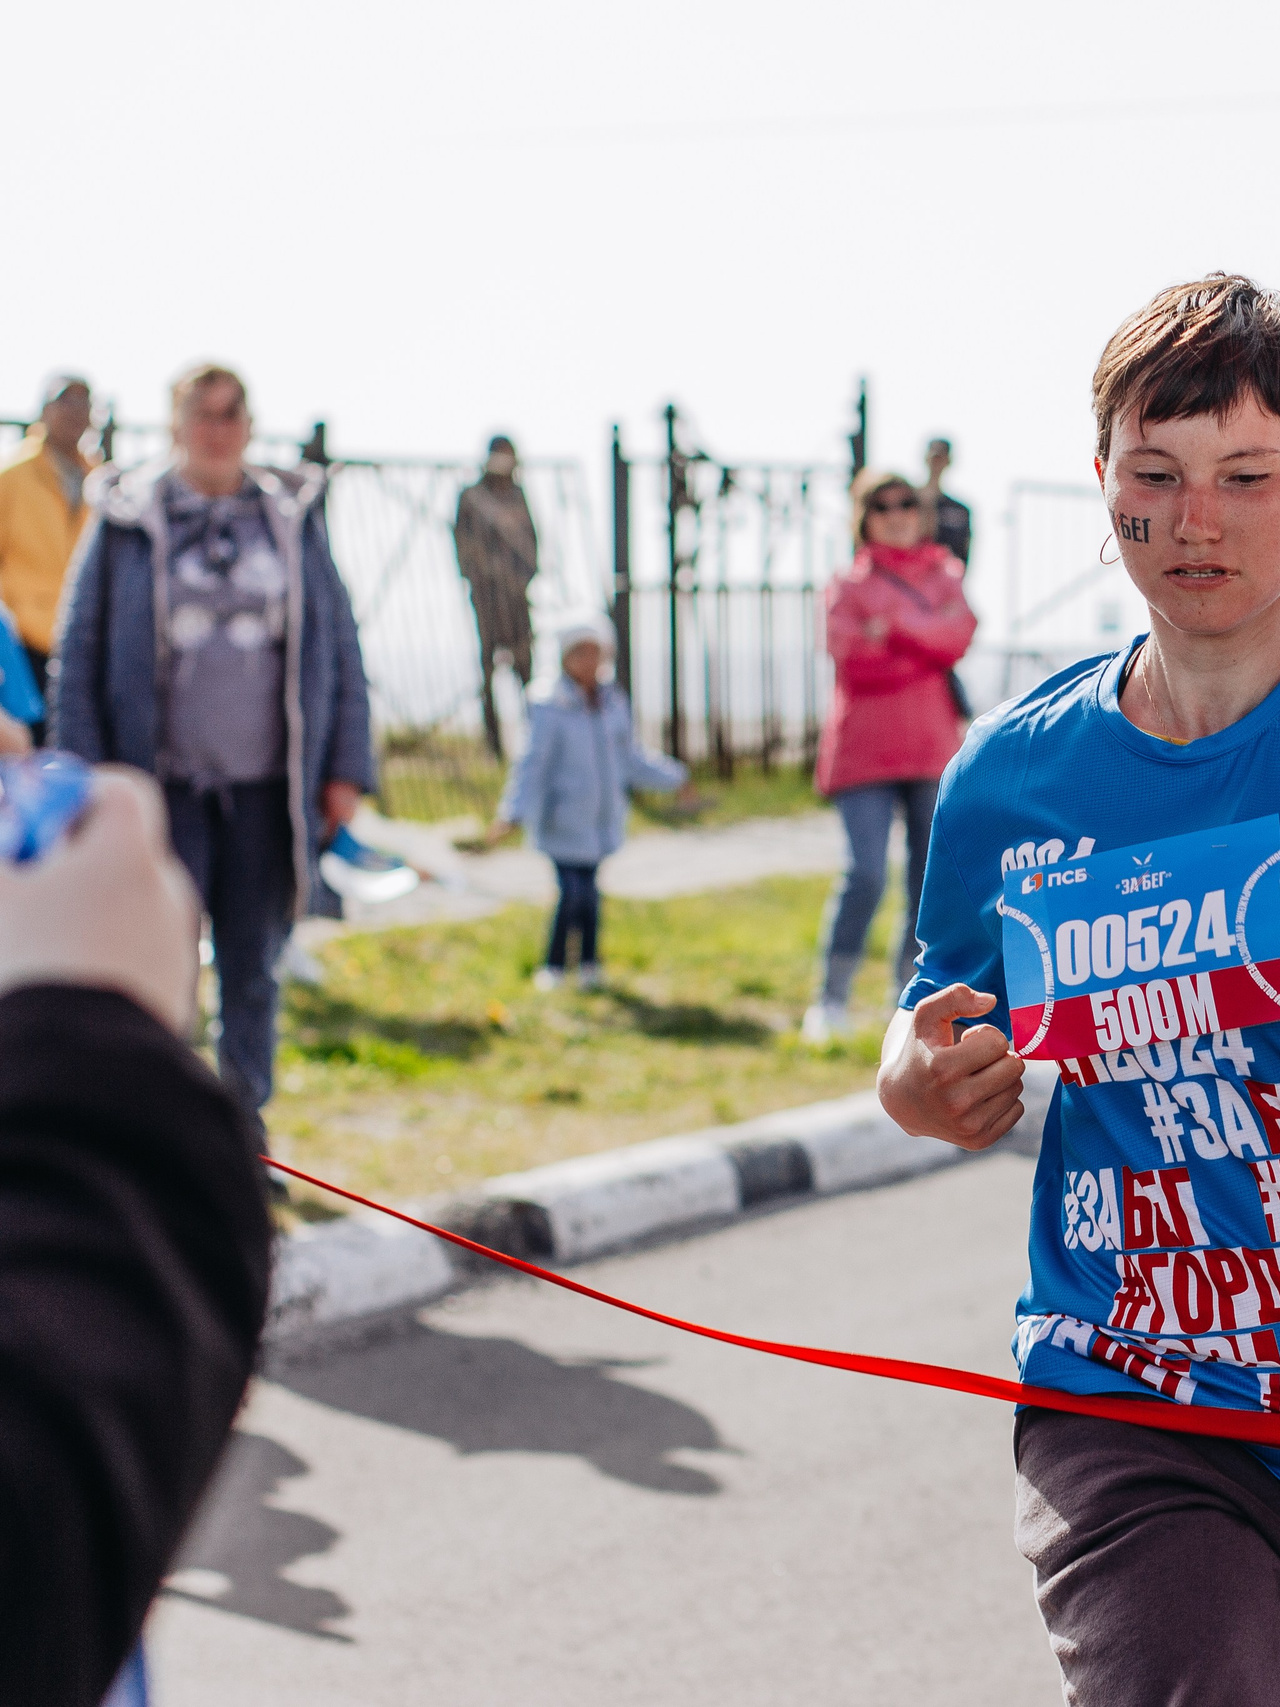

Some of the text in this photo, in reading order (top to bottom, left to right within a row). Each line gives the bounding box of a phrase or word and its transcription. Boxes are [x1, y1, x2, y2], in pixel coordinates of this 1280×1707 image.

[1119, 513, 1151, 543] БЕГ
[1048, 868, 1087, 887] ПСБ
[1056, 890, 1236, 986] 00524
